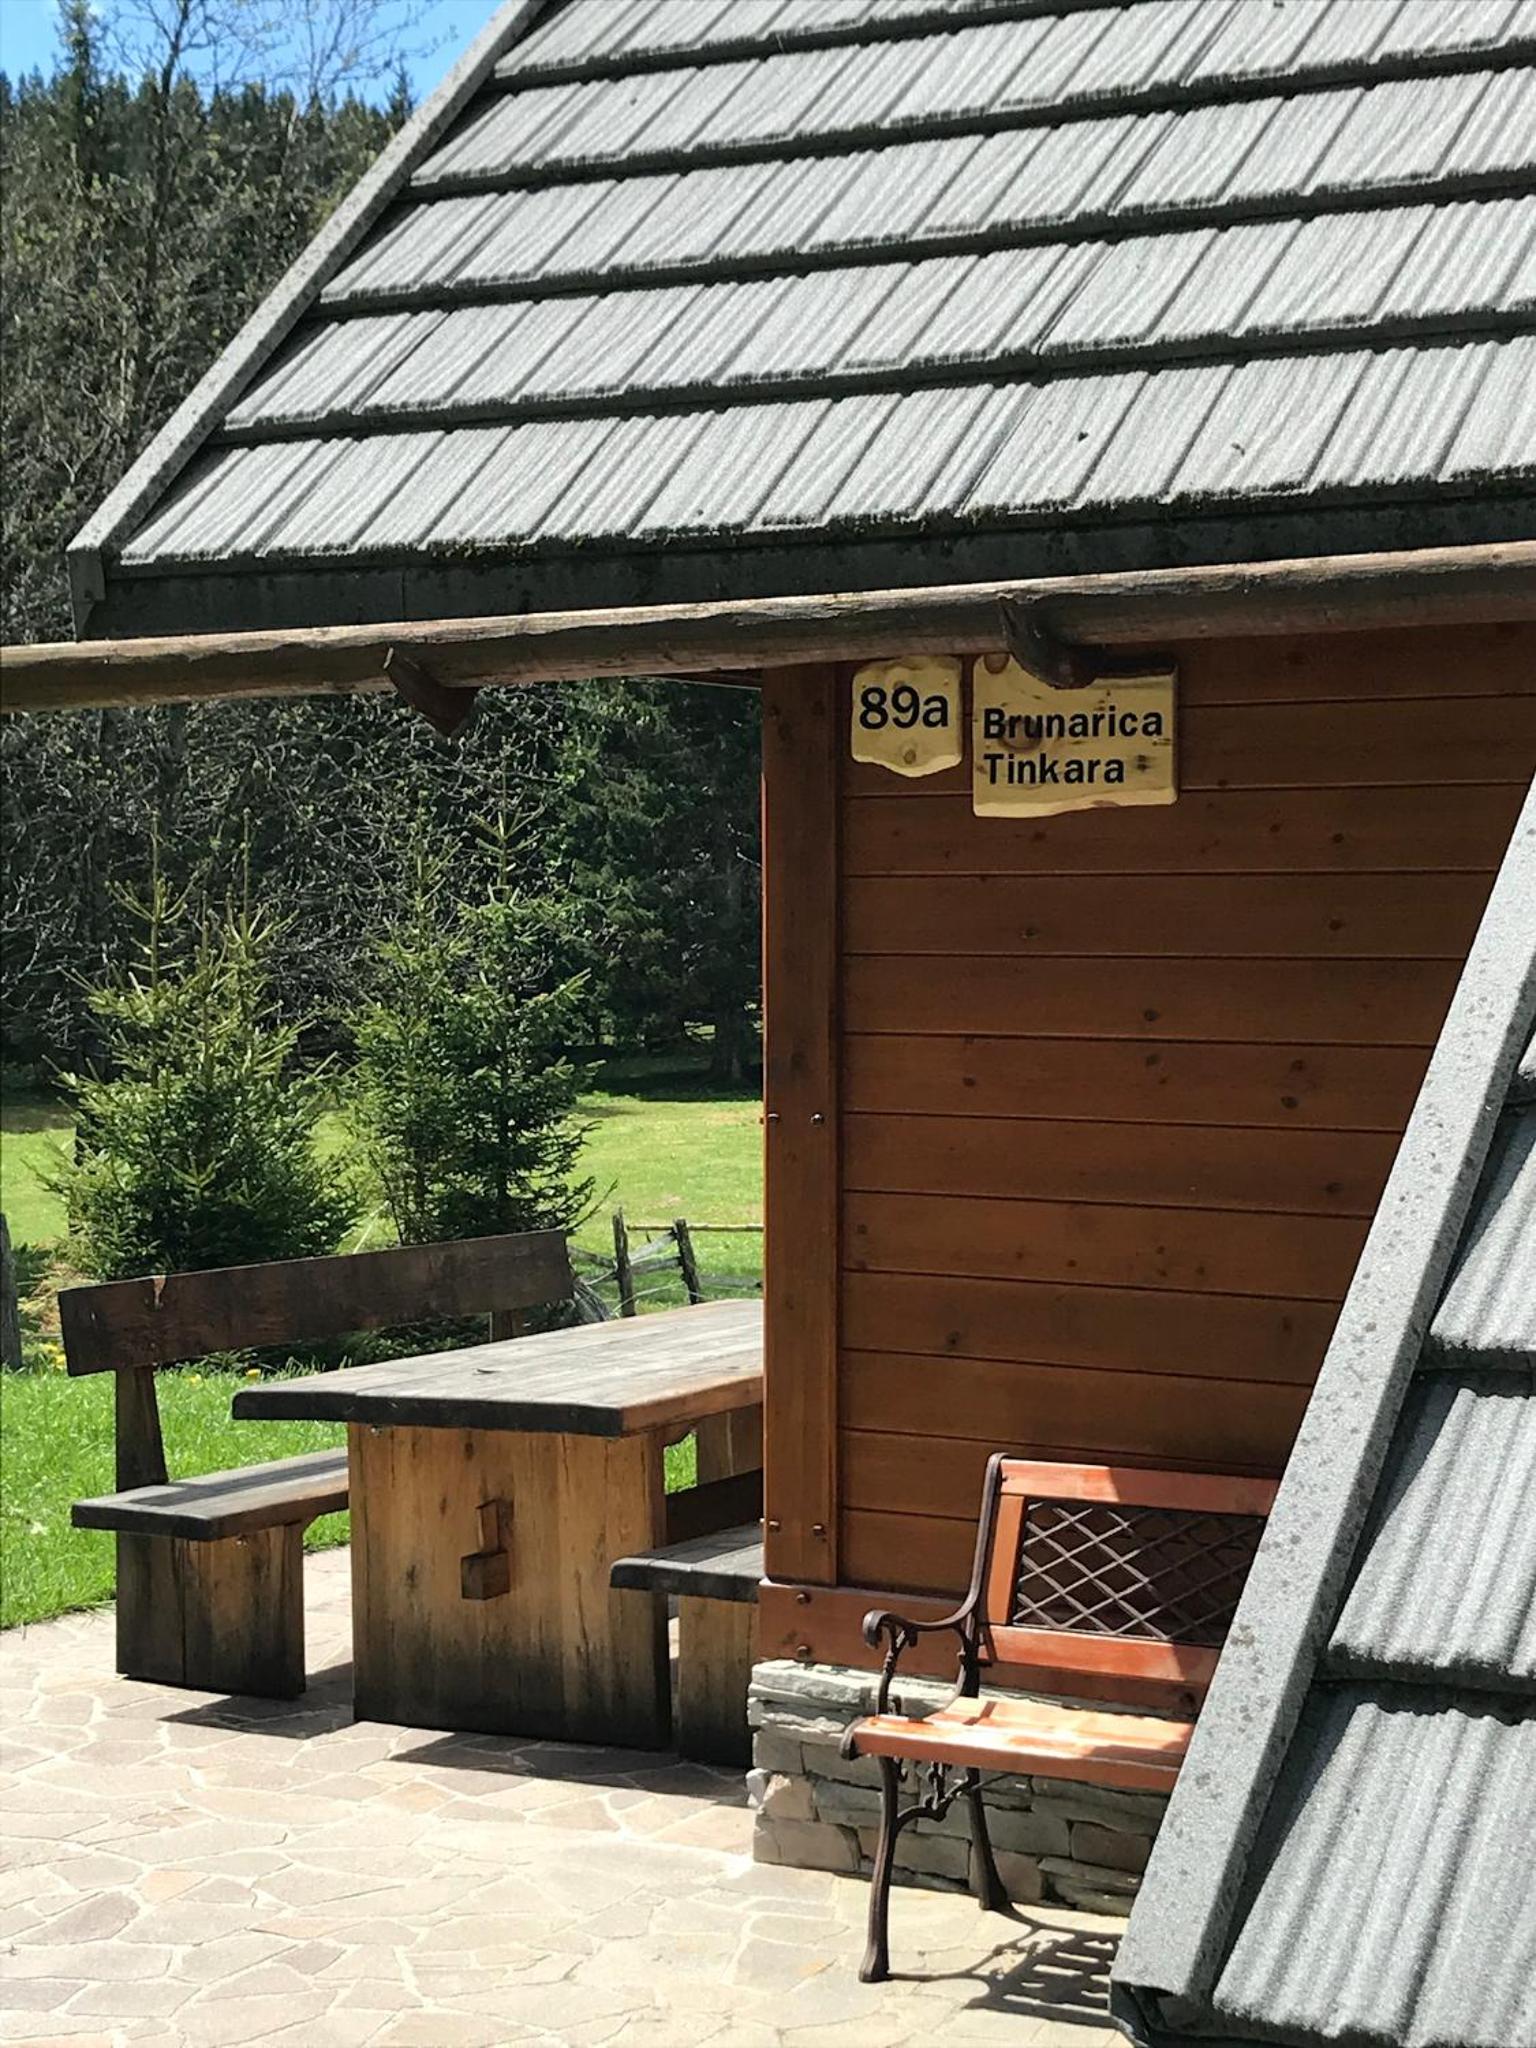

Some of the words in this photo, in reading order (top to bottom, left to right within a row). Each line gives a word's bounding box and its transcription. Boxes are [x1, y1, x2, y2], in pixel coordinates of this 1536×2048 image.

[859, 685, 949, 730] 89a
[982, 706, 1163, 740] Brunarica
[983, 753, 1125, 785] Tinkara
